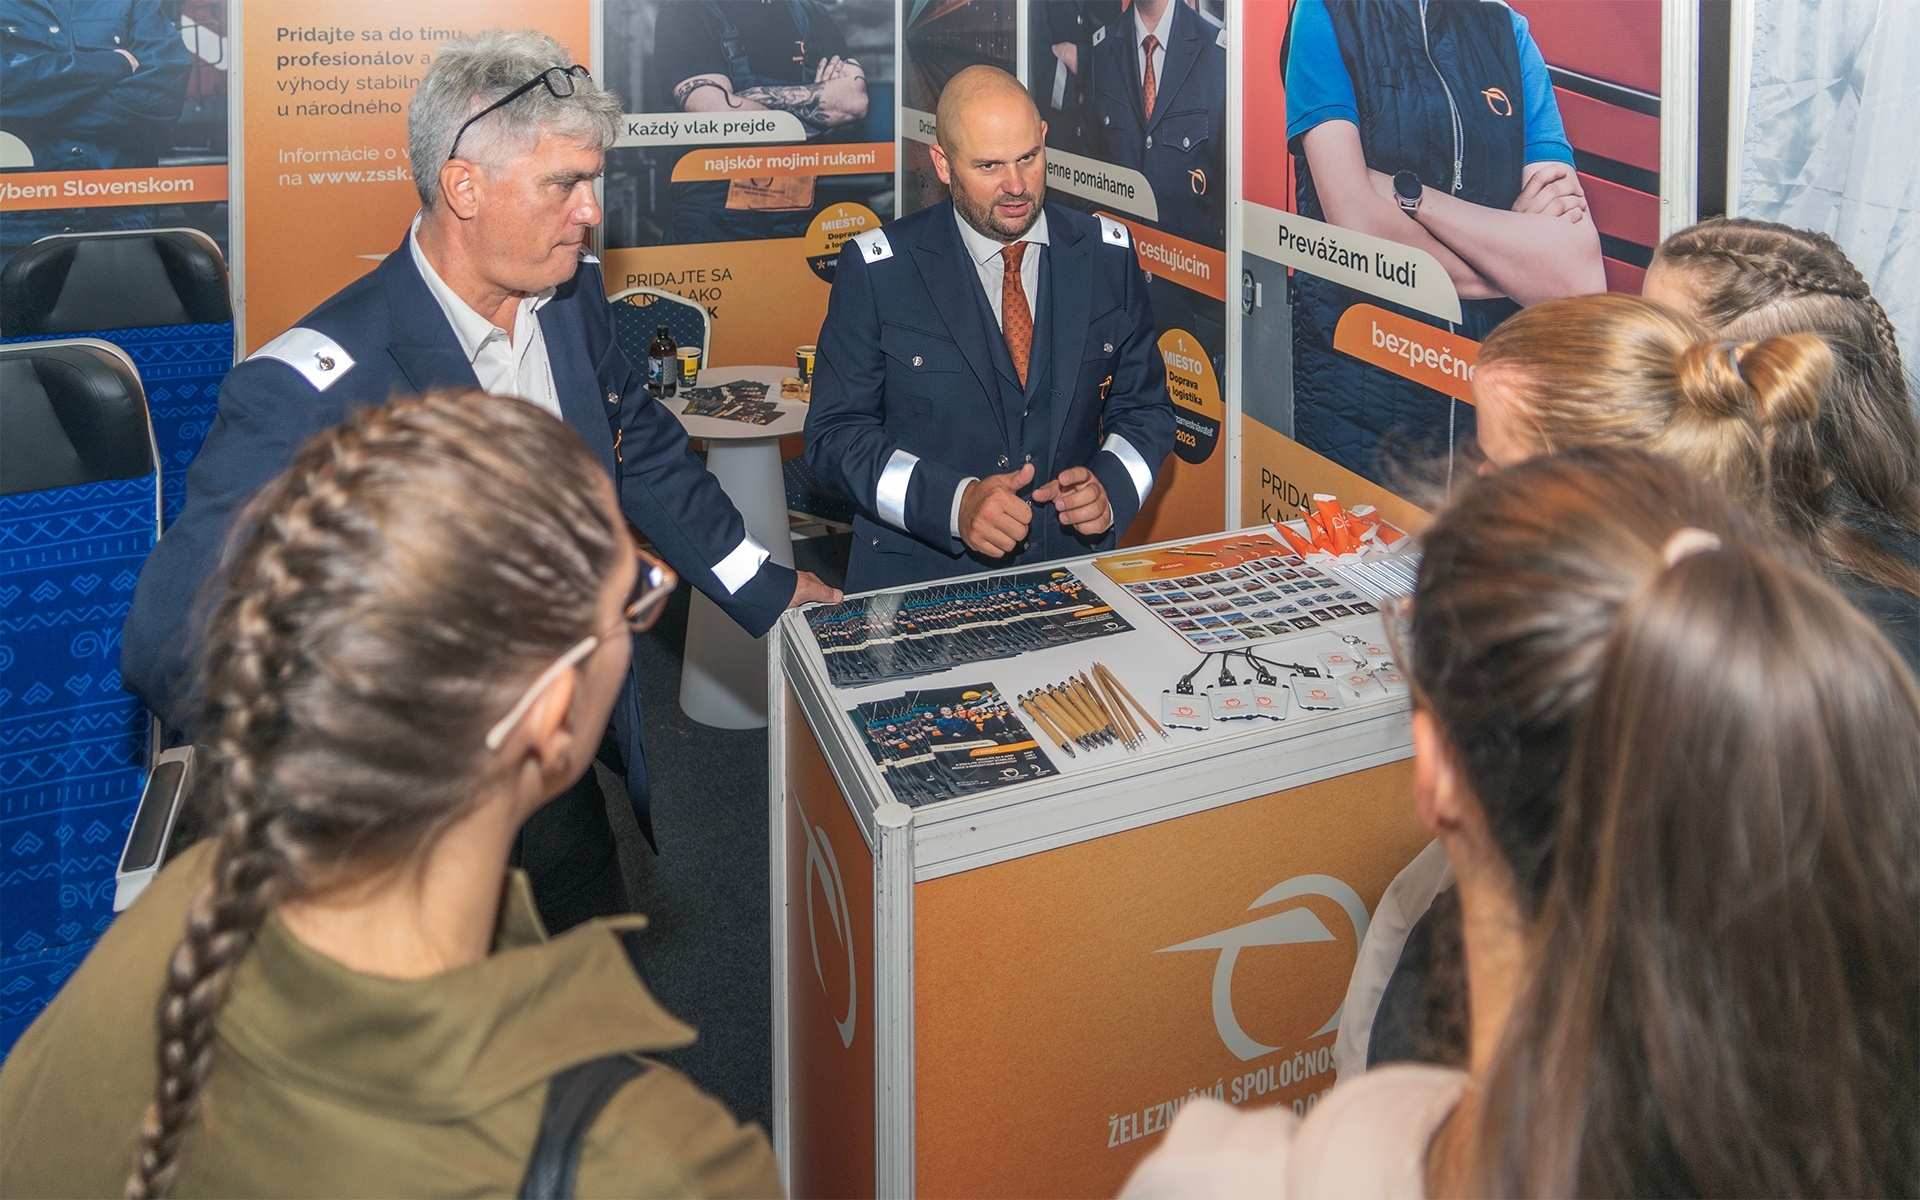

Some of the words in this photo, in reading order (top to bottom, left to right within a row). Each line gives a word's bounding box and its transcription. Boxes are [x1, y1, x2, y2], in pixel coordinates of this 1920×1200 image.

[277, 27, 355, 45] Pridajte
[361, 29, 383, 41] sa
[389, 26, 414, 41] do
[277, 51, 415, 70] profesionálov
[420, 54, 431, 65] a
[277, 76, 350, 96] výhody
[277, 104, 289, 117] u
[296, 99, 402, 116] národného
[628, 121, 679, 138] Každý
[683, 119, 719, 134] vlak
[723, 118, 776, 137] prejde
[279, 147, 380, 164] Informácie
[384, 148, 397, 160] o
[704, 155, 763, 173] najskôr
[766, 152, 819, 170] mojimi
[823, 150, 876, 167] rukami
[63, 177, 194, 197] Slovenskom
[279, 172, 302, 186] na
[1046, 161, 1071, 179] enne
[1074, 169, 1135, 199] pomáhame
[837, 207, 848, 217] 1.
[821, 215, 865, 231] MIESTO
[1139, 240, 1210, 280] cestujúcim
[1278, 225, 1369, 273] Prevážam
[1375, 252, 1417, 288] ľudí
[626, 269, 706, 288] PRIDAJTE
[711, 268, 733, 282] SA
[688, 287, 722, 302] AKO
[1177, 338, 1187, 352] 1.
[1163, 350, 1203, 375] MIESTO
[1168, 370, 1198, 390] Doprava
[1172, 385, 1203, 406] logistika
[1175, 429, 1197, 448] 2023
[1261, 498, 1272, 523] K
